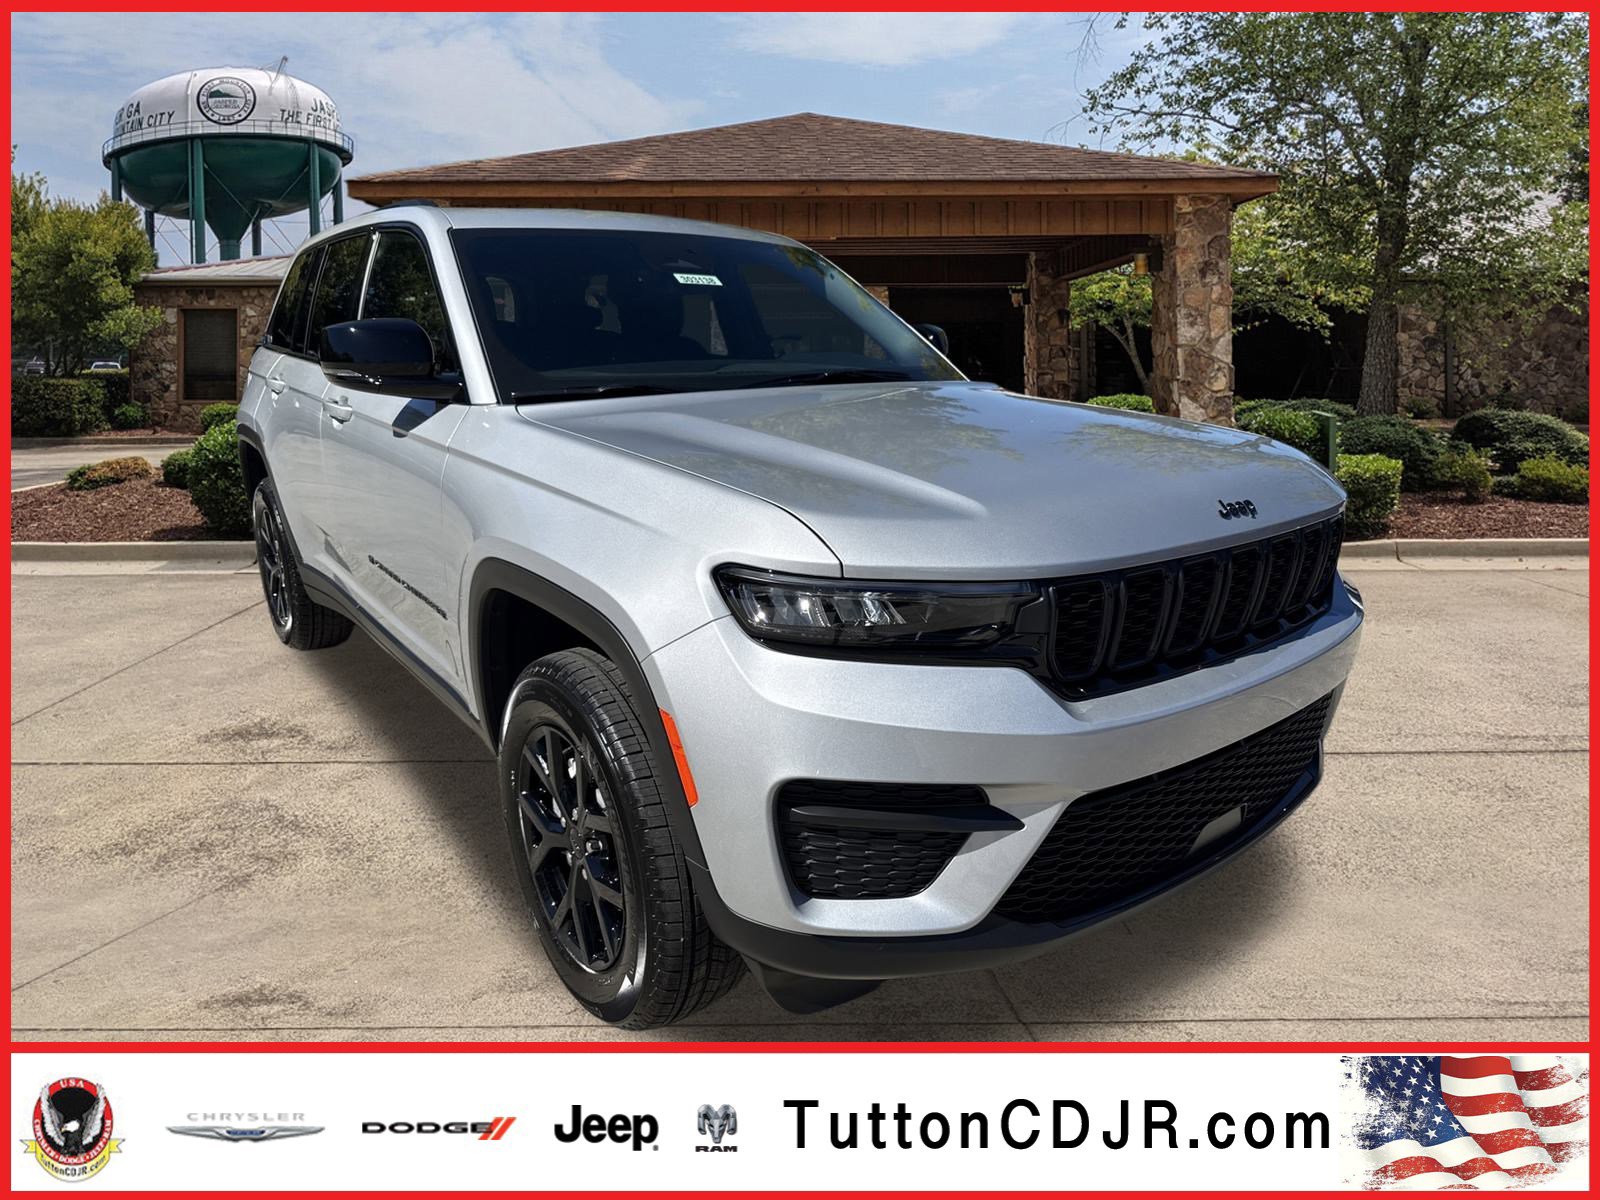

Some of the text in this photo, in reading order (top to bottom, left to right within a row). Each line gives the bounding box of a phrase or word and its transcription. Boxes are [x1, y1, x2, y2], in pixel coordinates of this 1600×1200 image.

[127, 101, 140, 119] GA
[147, 110, 175, 127] CITY
[280, 109, 302, 124] THE
[306, 112, 332, 129] FIRST
[1218, 499, 1258, 520] Jeep
